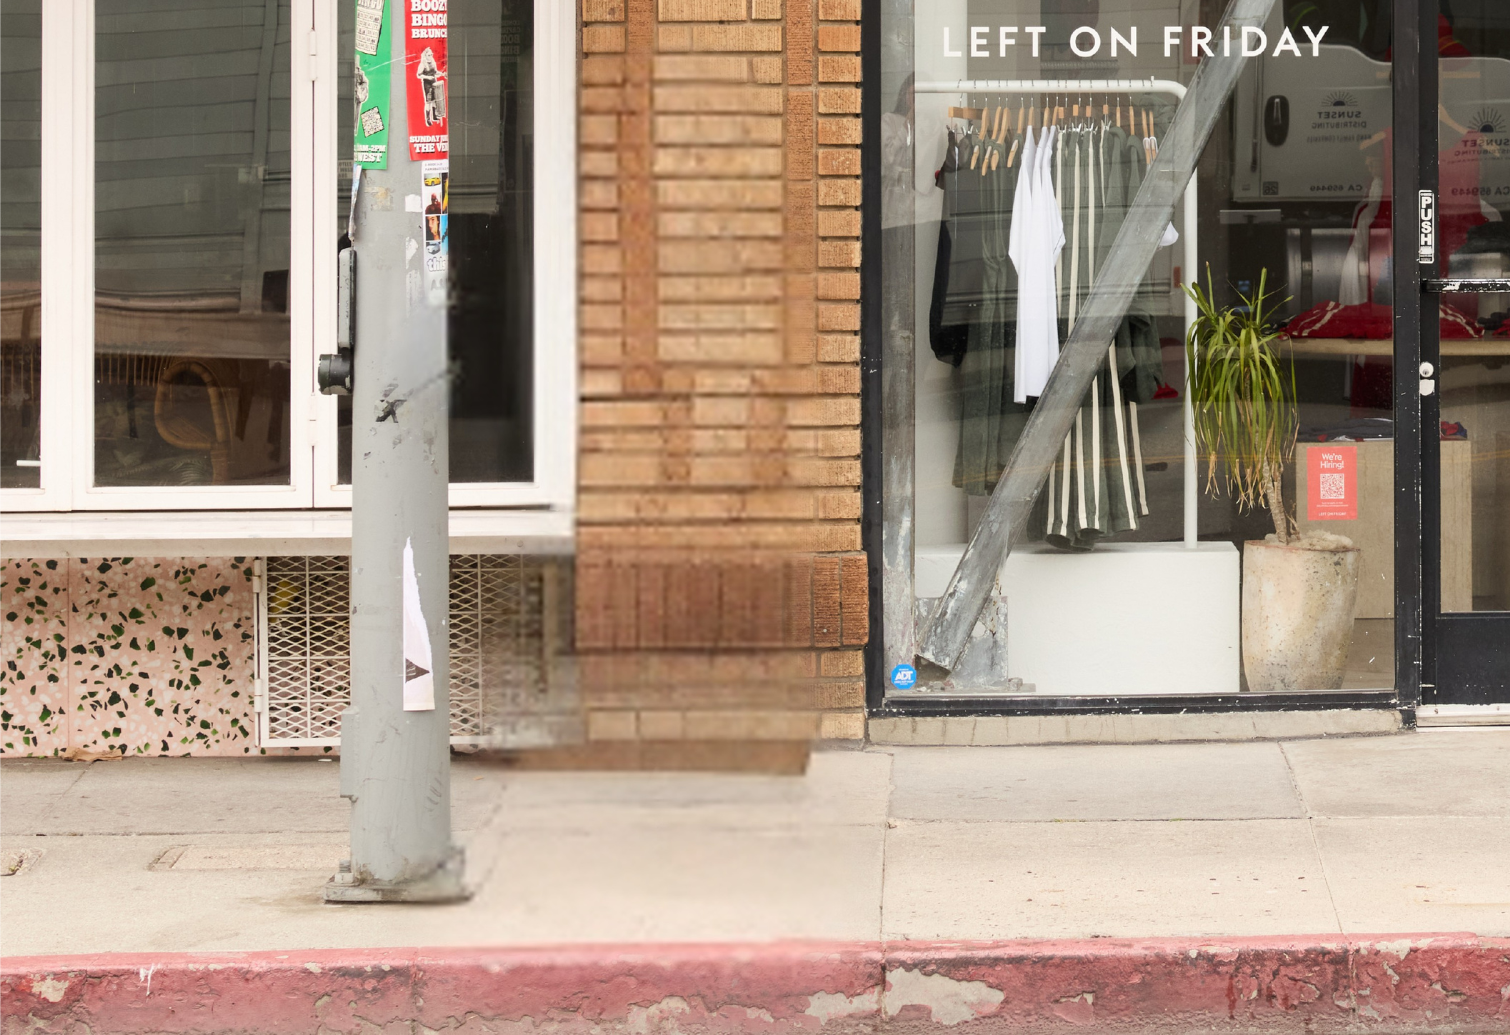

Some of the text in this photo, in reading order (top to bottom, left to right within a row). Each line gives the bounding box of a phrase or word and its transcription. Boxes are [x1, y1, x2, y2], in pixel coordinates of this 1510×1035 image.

[943, 25, 1331, 58] LEFT ON FRIDAY
[413, 143, 435, 153] THE
[1420, 196, 1432, 246] PUSH
[1321, 453, 1343, 461] We're
[1320, 460, 1345, 470] Hiring!
[894, 670, 914, 681] ADT
